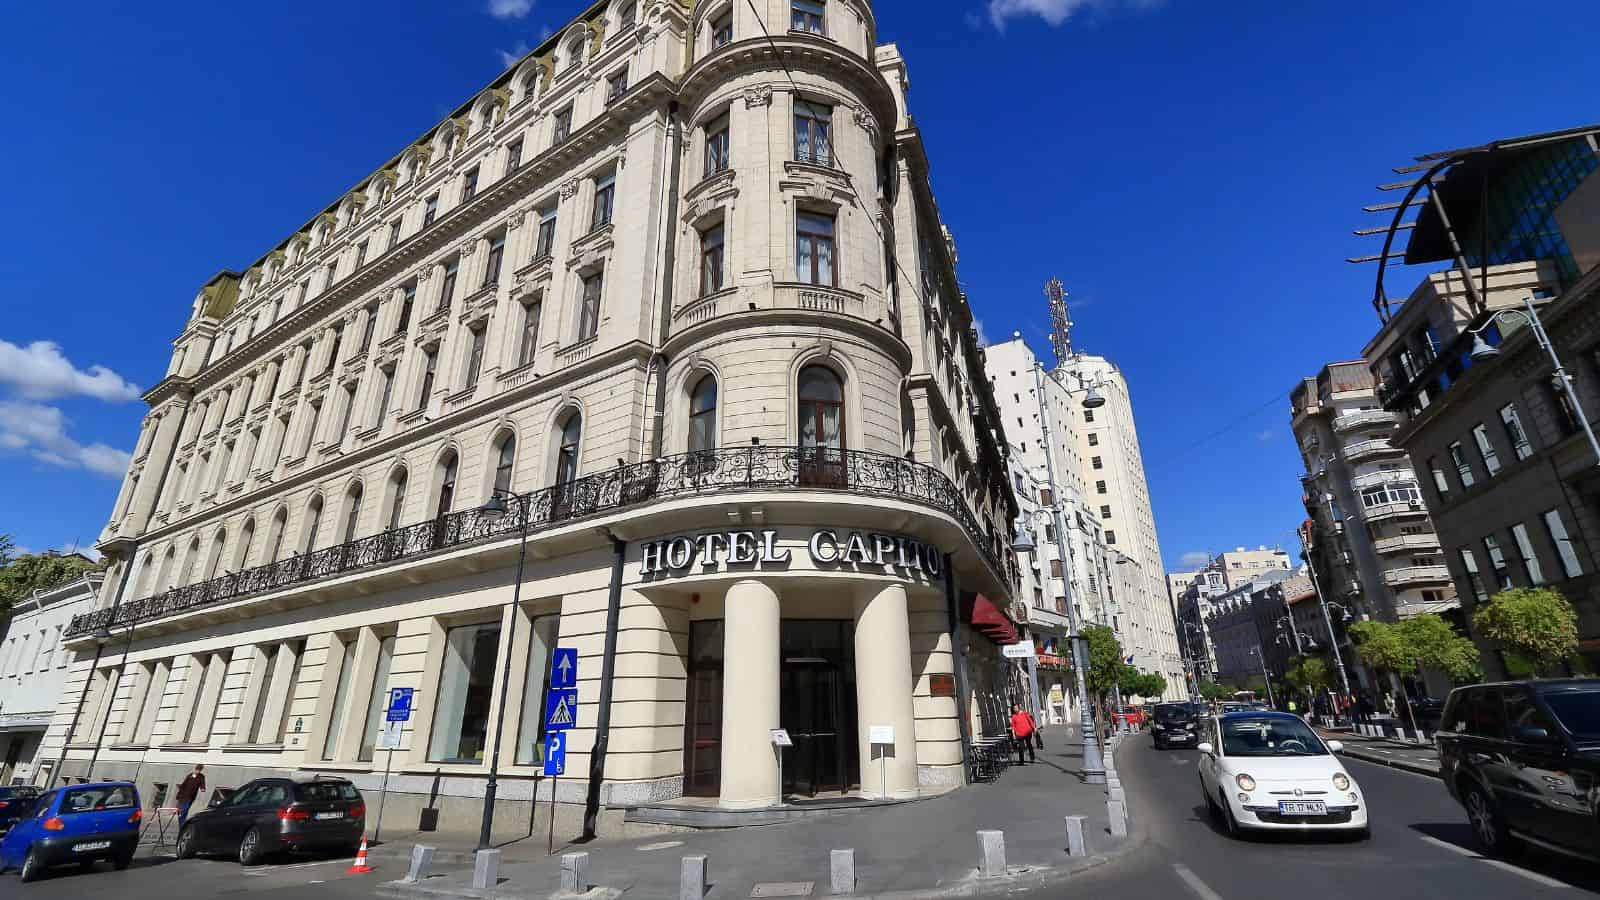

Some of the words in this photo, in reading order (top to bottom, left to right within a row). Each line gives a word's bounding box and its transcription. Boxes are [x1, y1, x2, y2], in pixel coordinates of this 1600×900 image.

[640, 530, 791, 574] HOTEL
[391, 690, 402, 708] P
[549, 737, 560, 761] P
